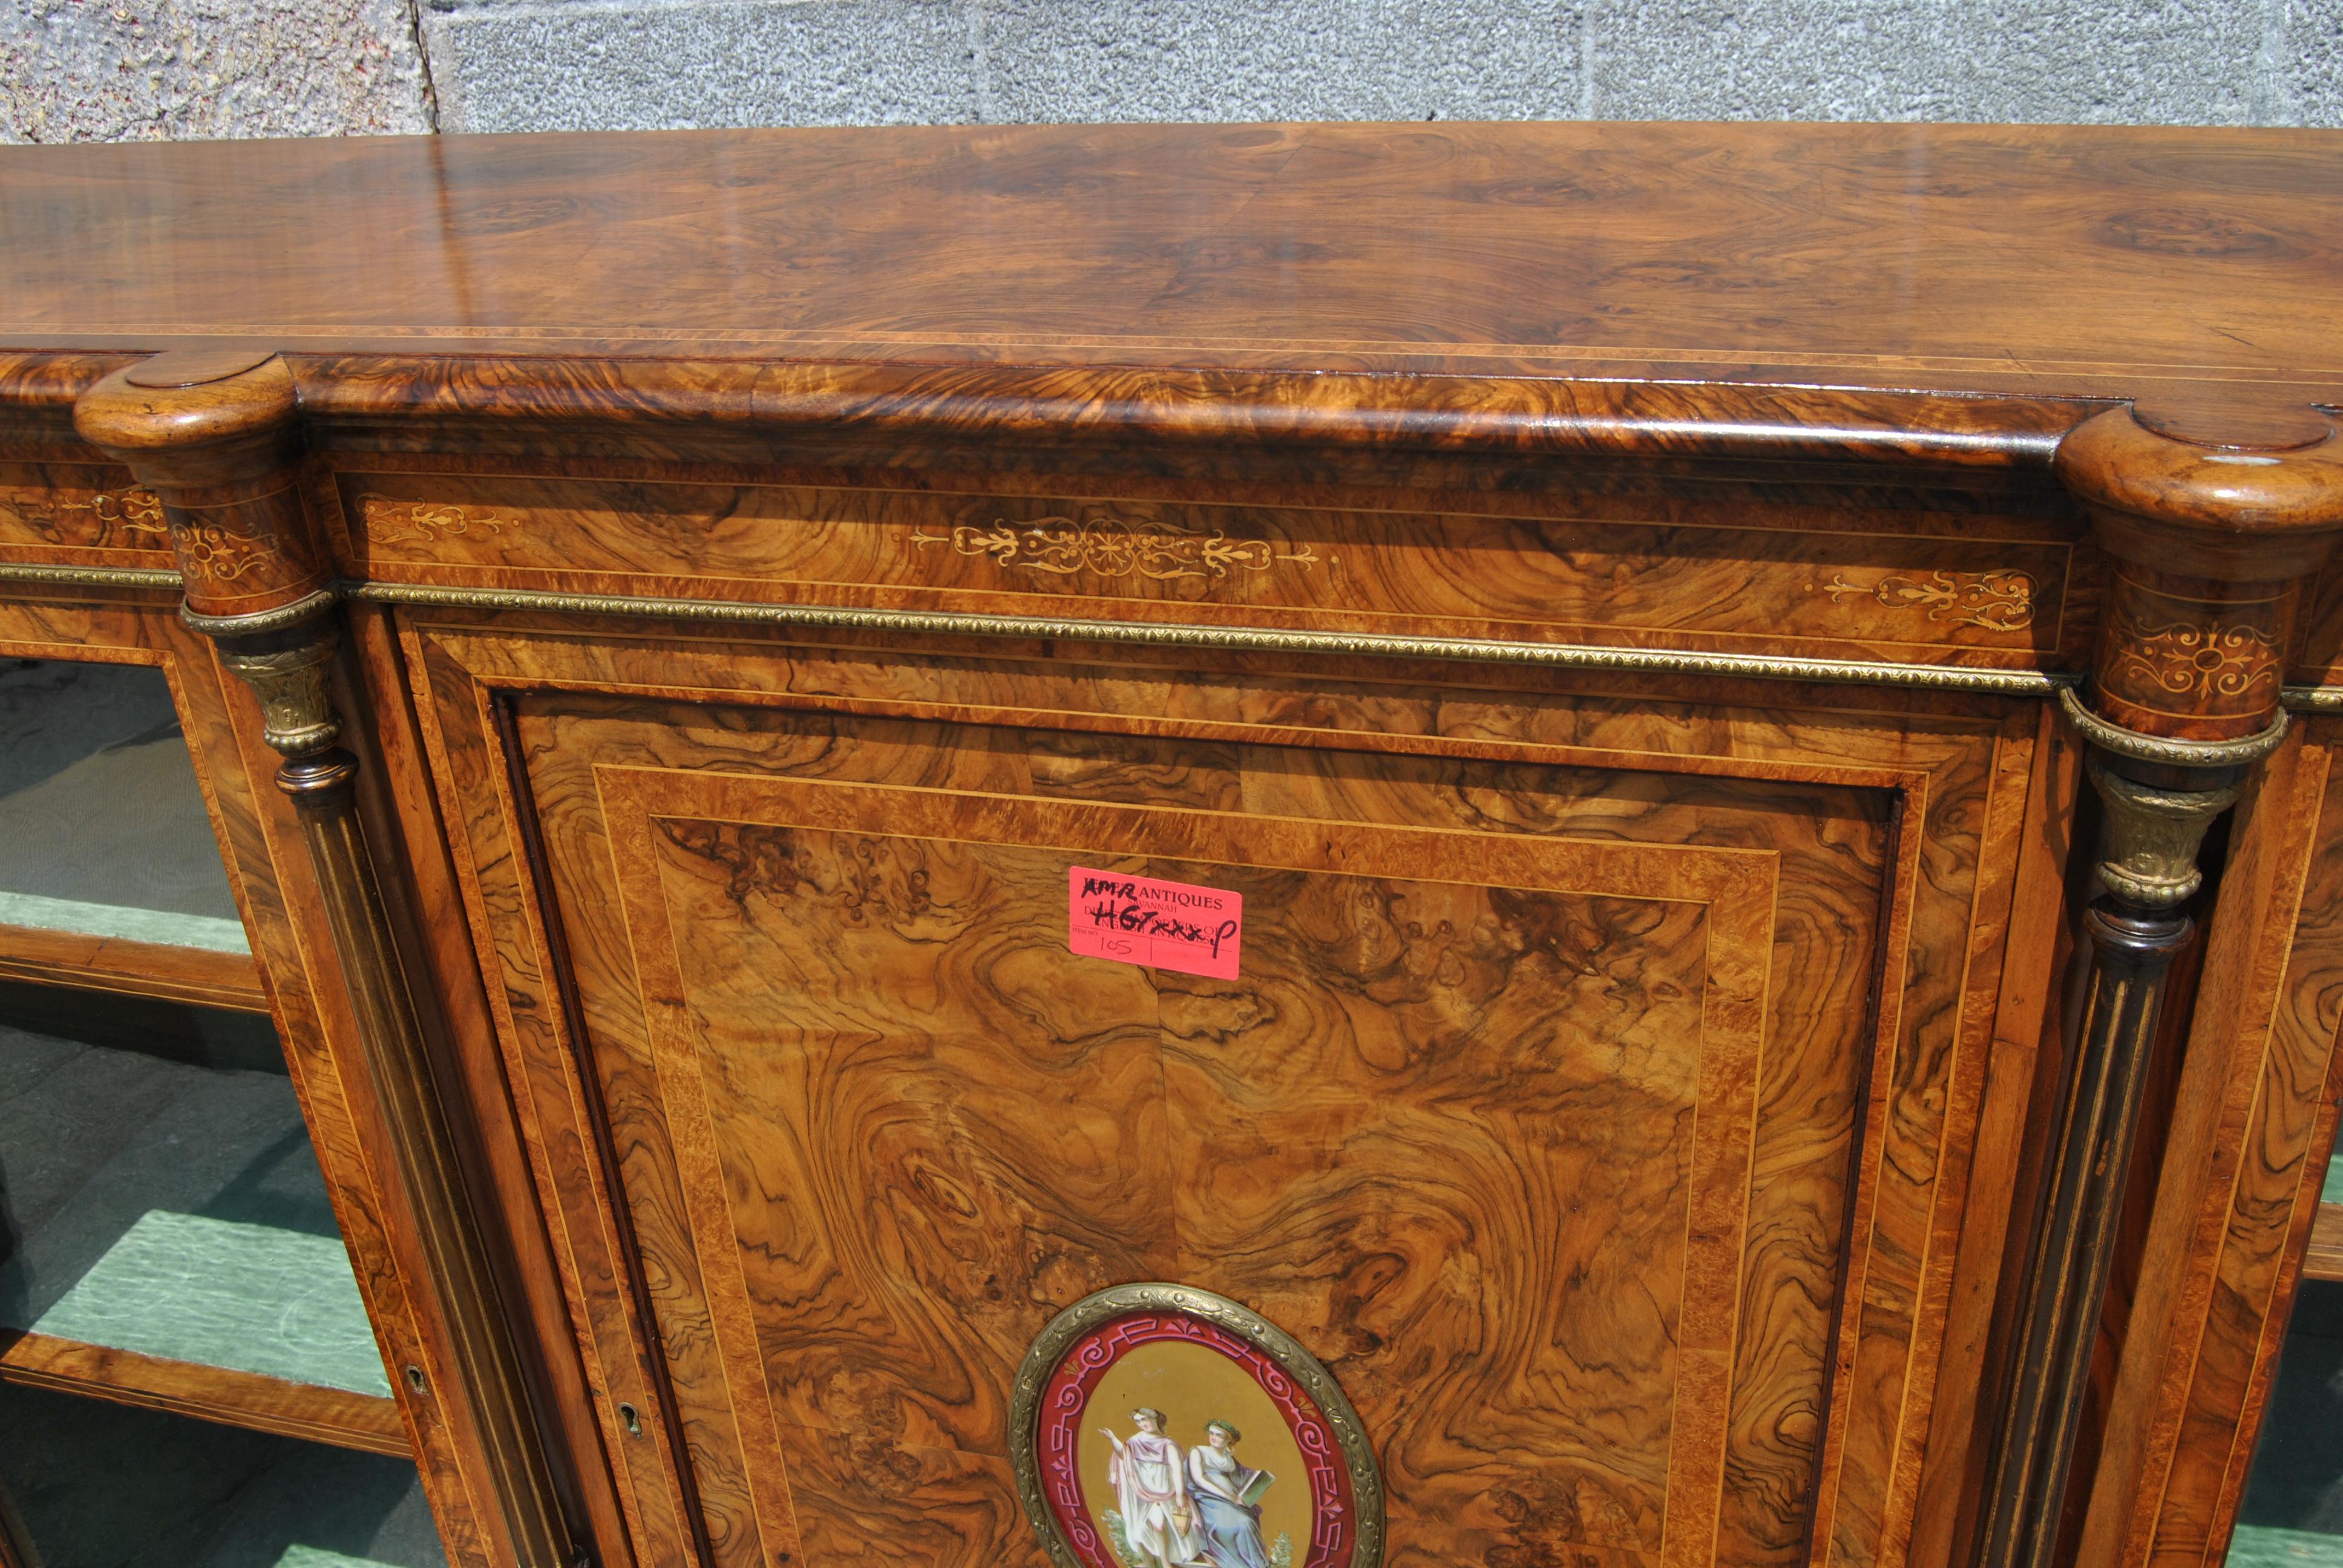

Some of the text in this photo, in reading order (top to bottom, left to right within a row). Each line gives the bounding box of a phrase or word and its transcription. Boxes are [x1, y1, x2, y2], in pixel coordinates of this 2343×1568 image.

[1127, 899, 1177, 913] SAVANNAH
[1139, 887, 1223, 910] ANTIQUES
[1101, 937, 1132, 955] 105
